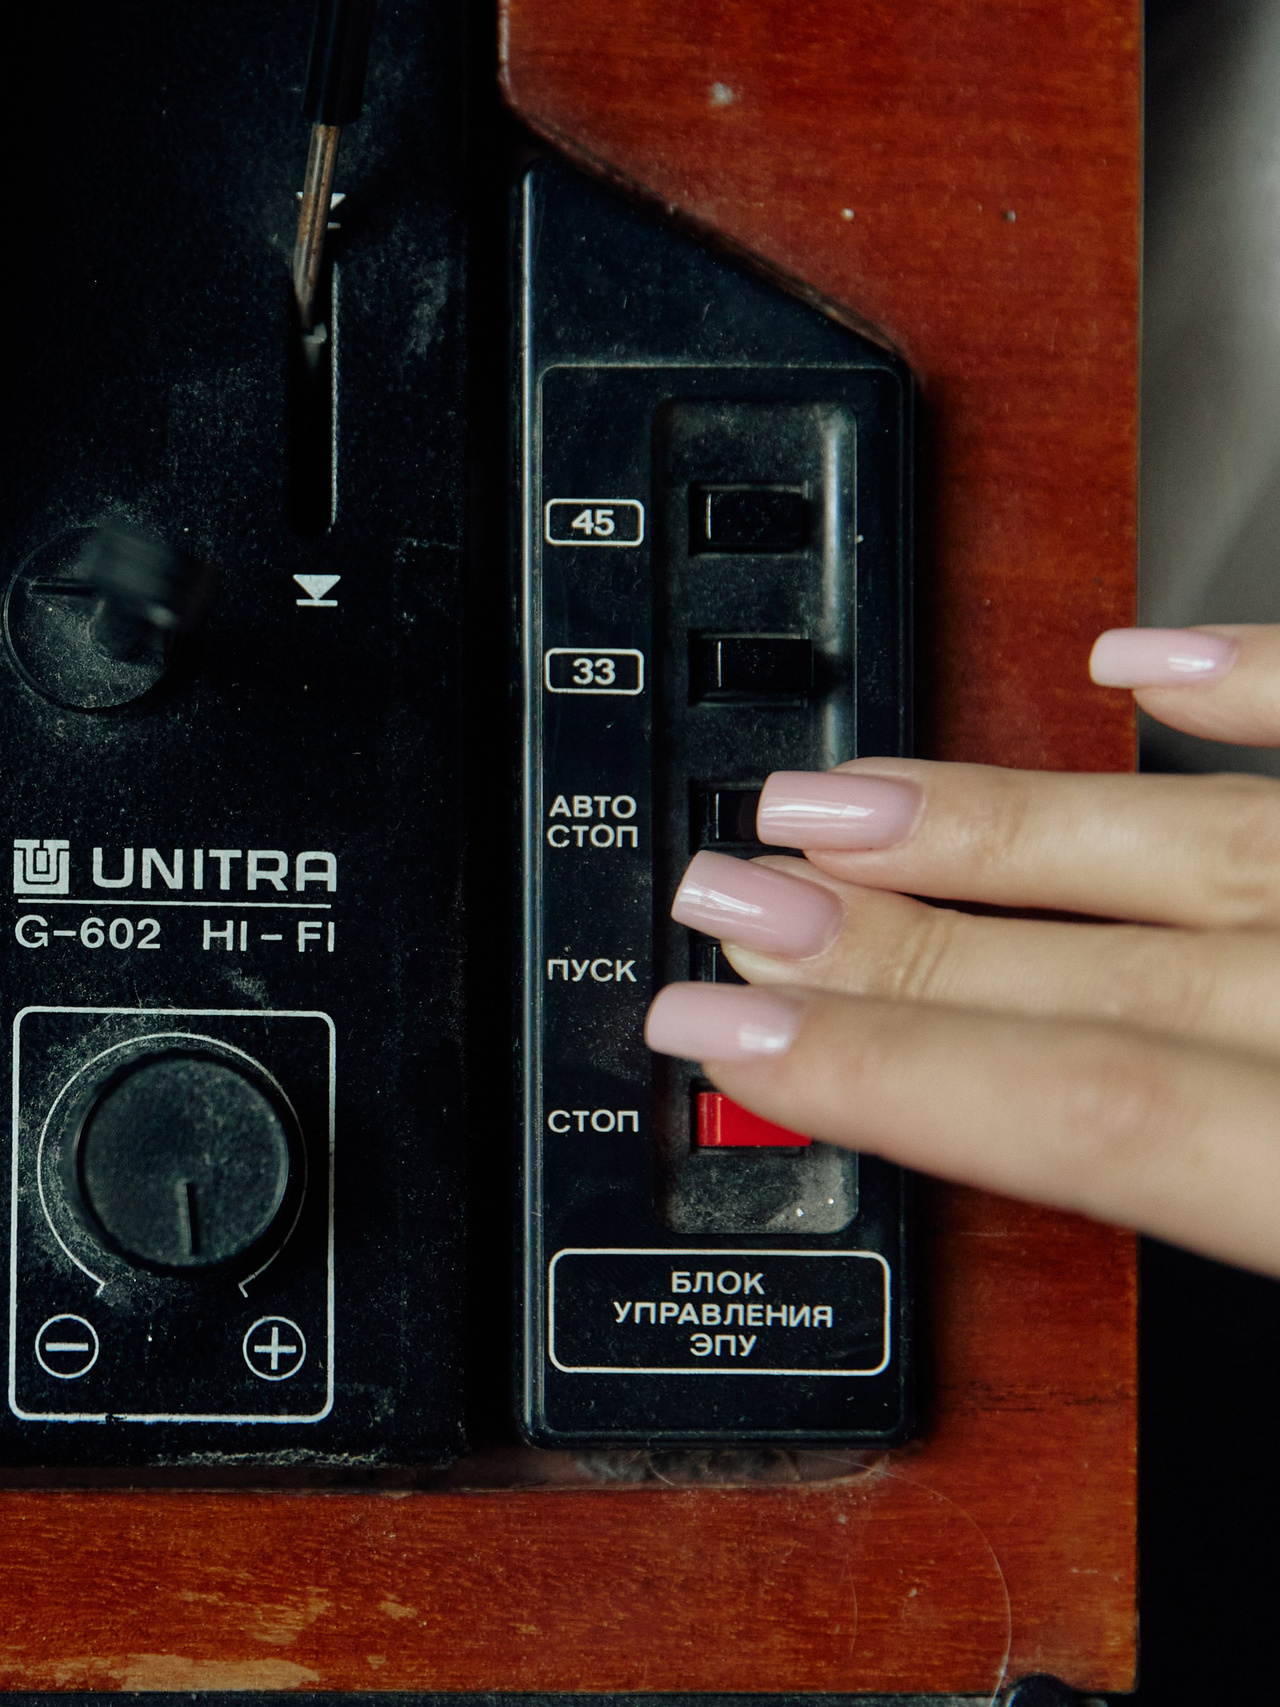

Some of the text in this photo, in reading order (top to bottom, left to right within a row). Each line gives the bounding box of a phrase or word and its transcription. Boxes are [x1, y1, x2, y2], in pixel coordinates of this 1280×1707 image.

[571, 509, 616, 536] 45
[572, 658, 617, 686] 33
[549, 795, 637, 819] АВТО
[547, 823, 639, 848] СТОП
[92, 847, 337, 892] UNITRA
[14, 914, 161, 949] G-602
[547, 958, 638, 983] ПУСК
[547, 1109, 639, 1133] СТОП
[671, 1270, 766, 1295] БЛОК
[613, 1301, 833, 1328] УПРАВЛЕНИЯ
[689, 1333, 757, 1357] ЭПУ
